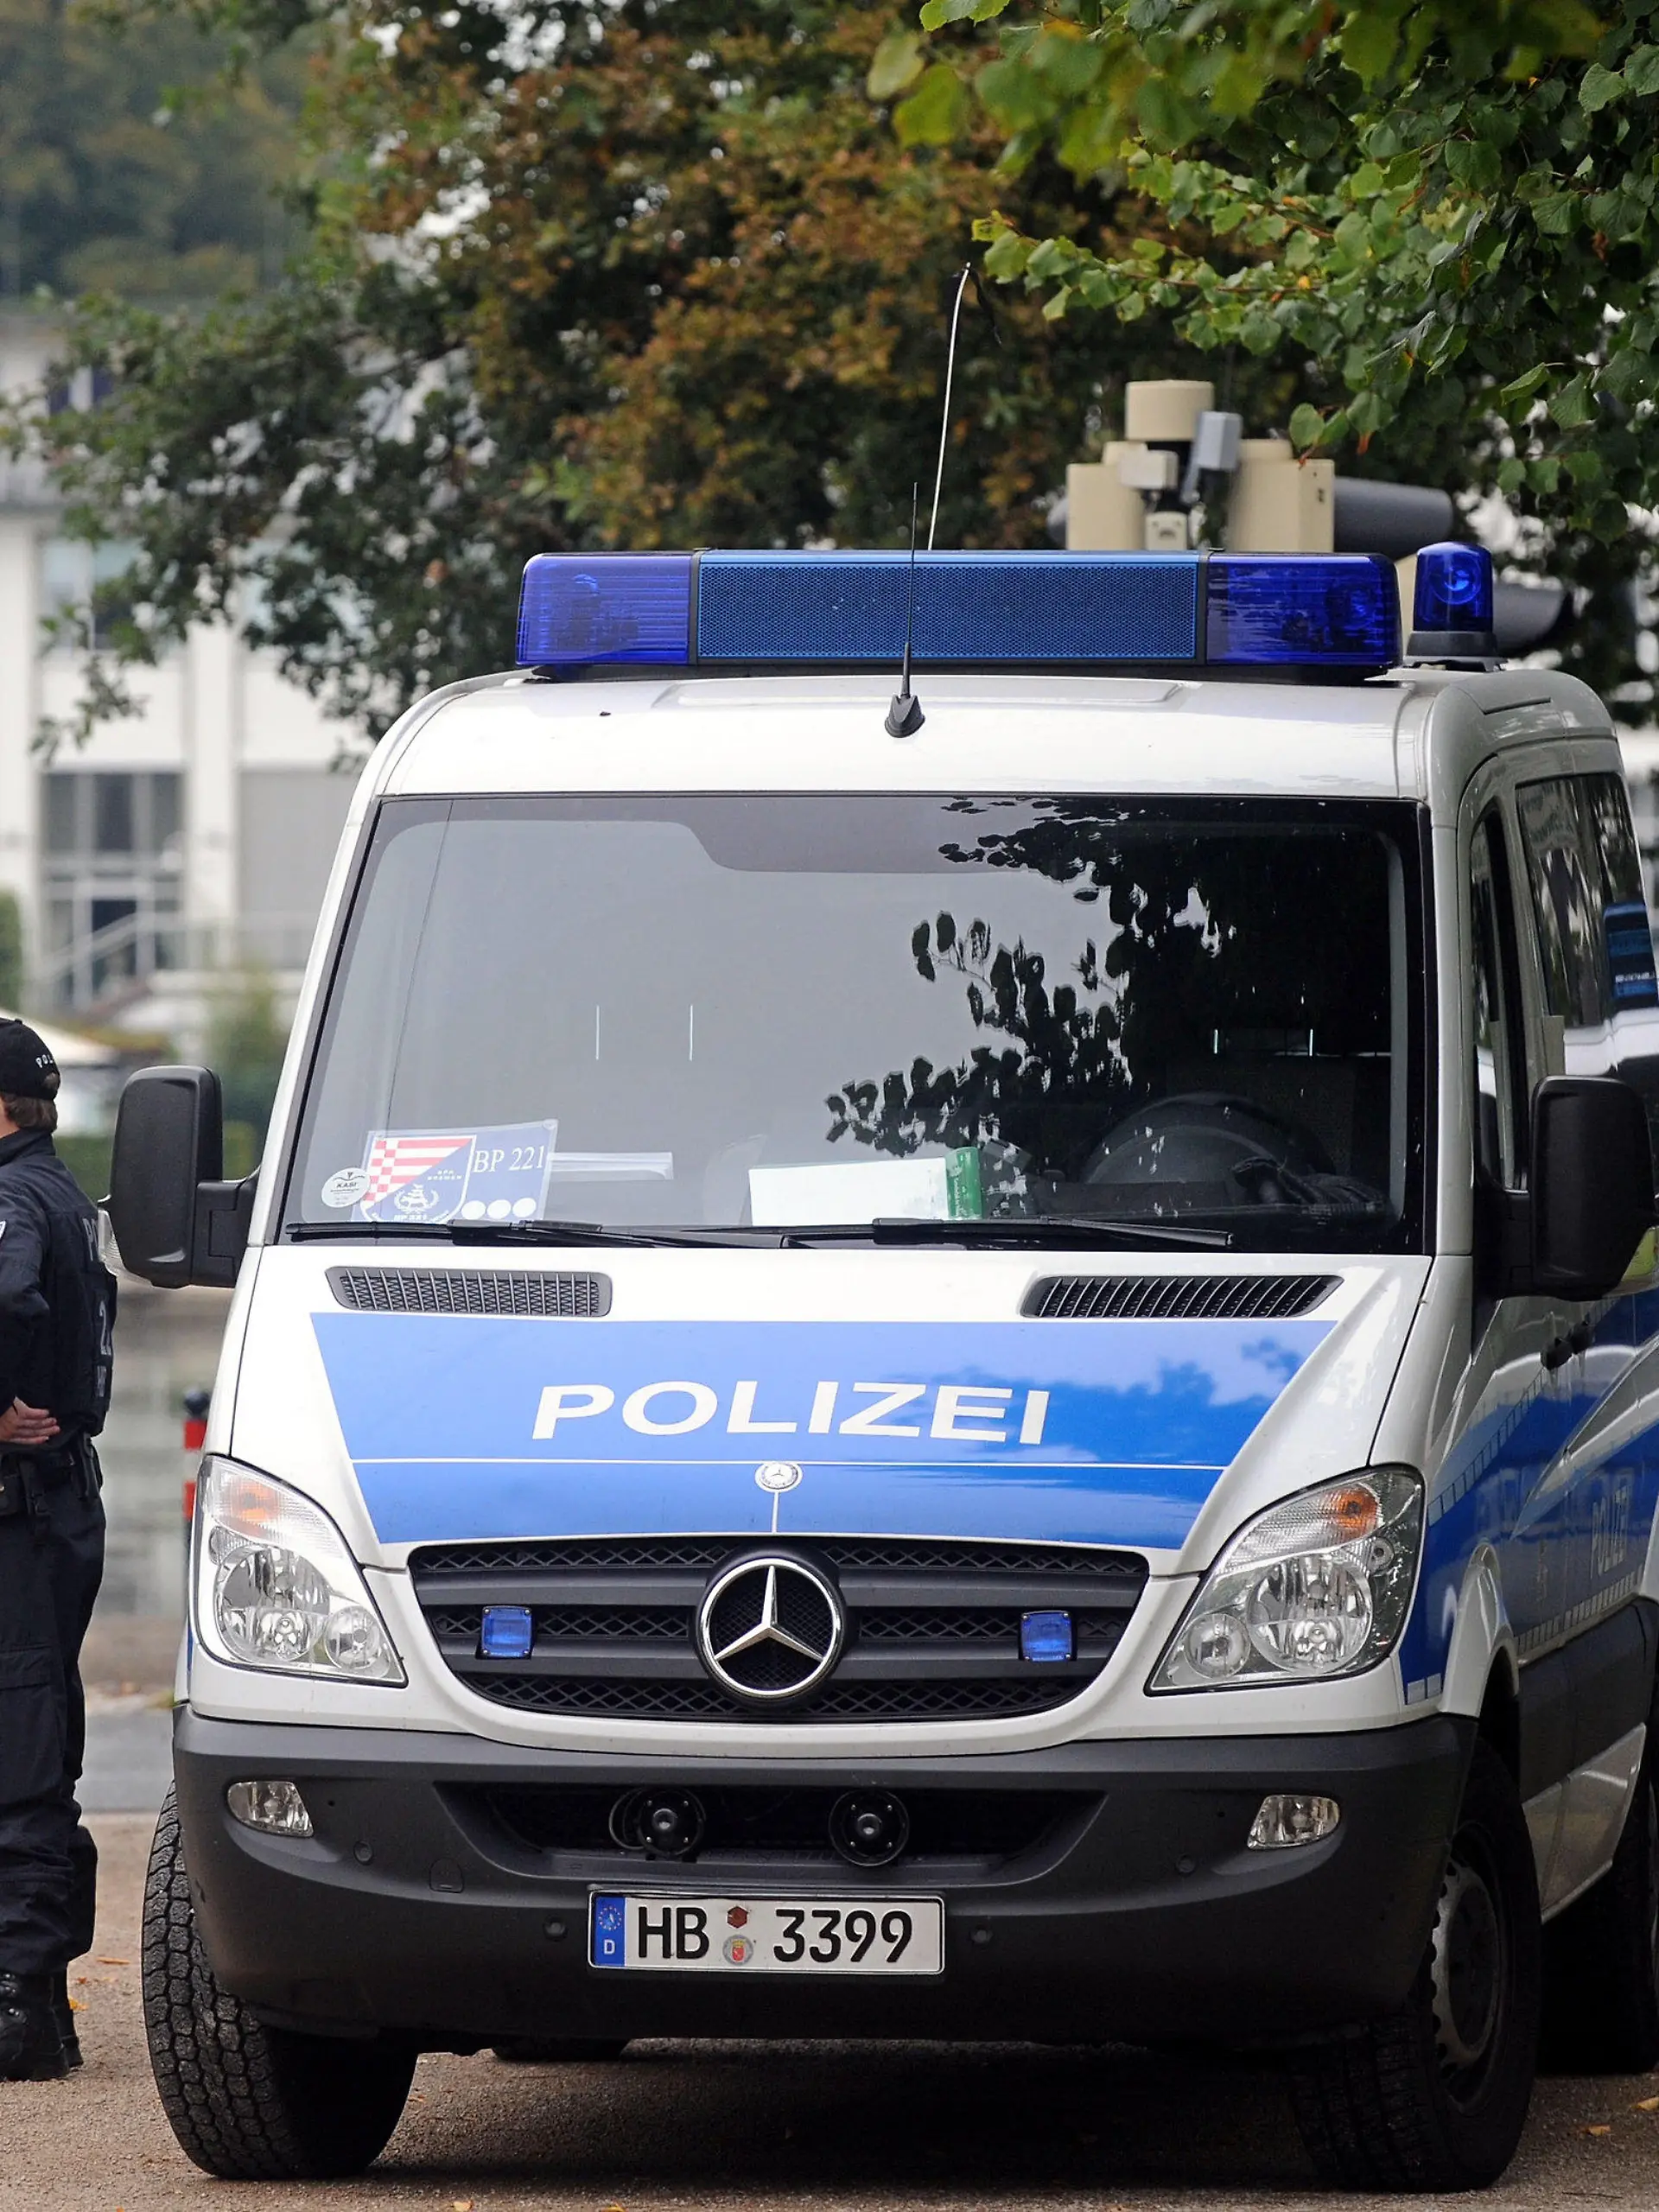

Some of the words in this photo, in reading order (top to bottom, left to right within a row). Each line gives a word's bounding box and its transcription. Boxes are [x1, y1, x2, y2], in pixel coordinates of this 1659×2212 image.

[473, 1149, 505, 1173] BP
[508, 1145, 544, 1171] 221
[531, 1381, 1050, 1445] POLIZEI
[604, 1939, 616, 1955] D
[638, 1906, 709, 1960] HB
[773, 1910, 912, 1963] 3399
